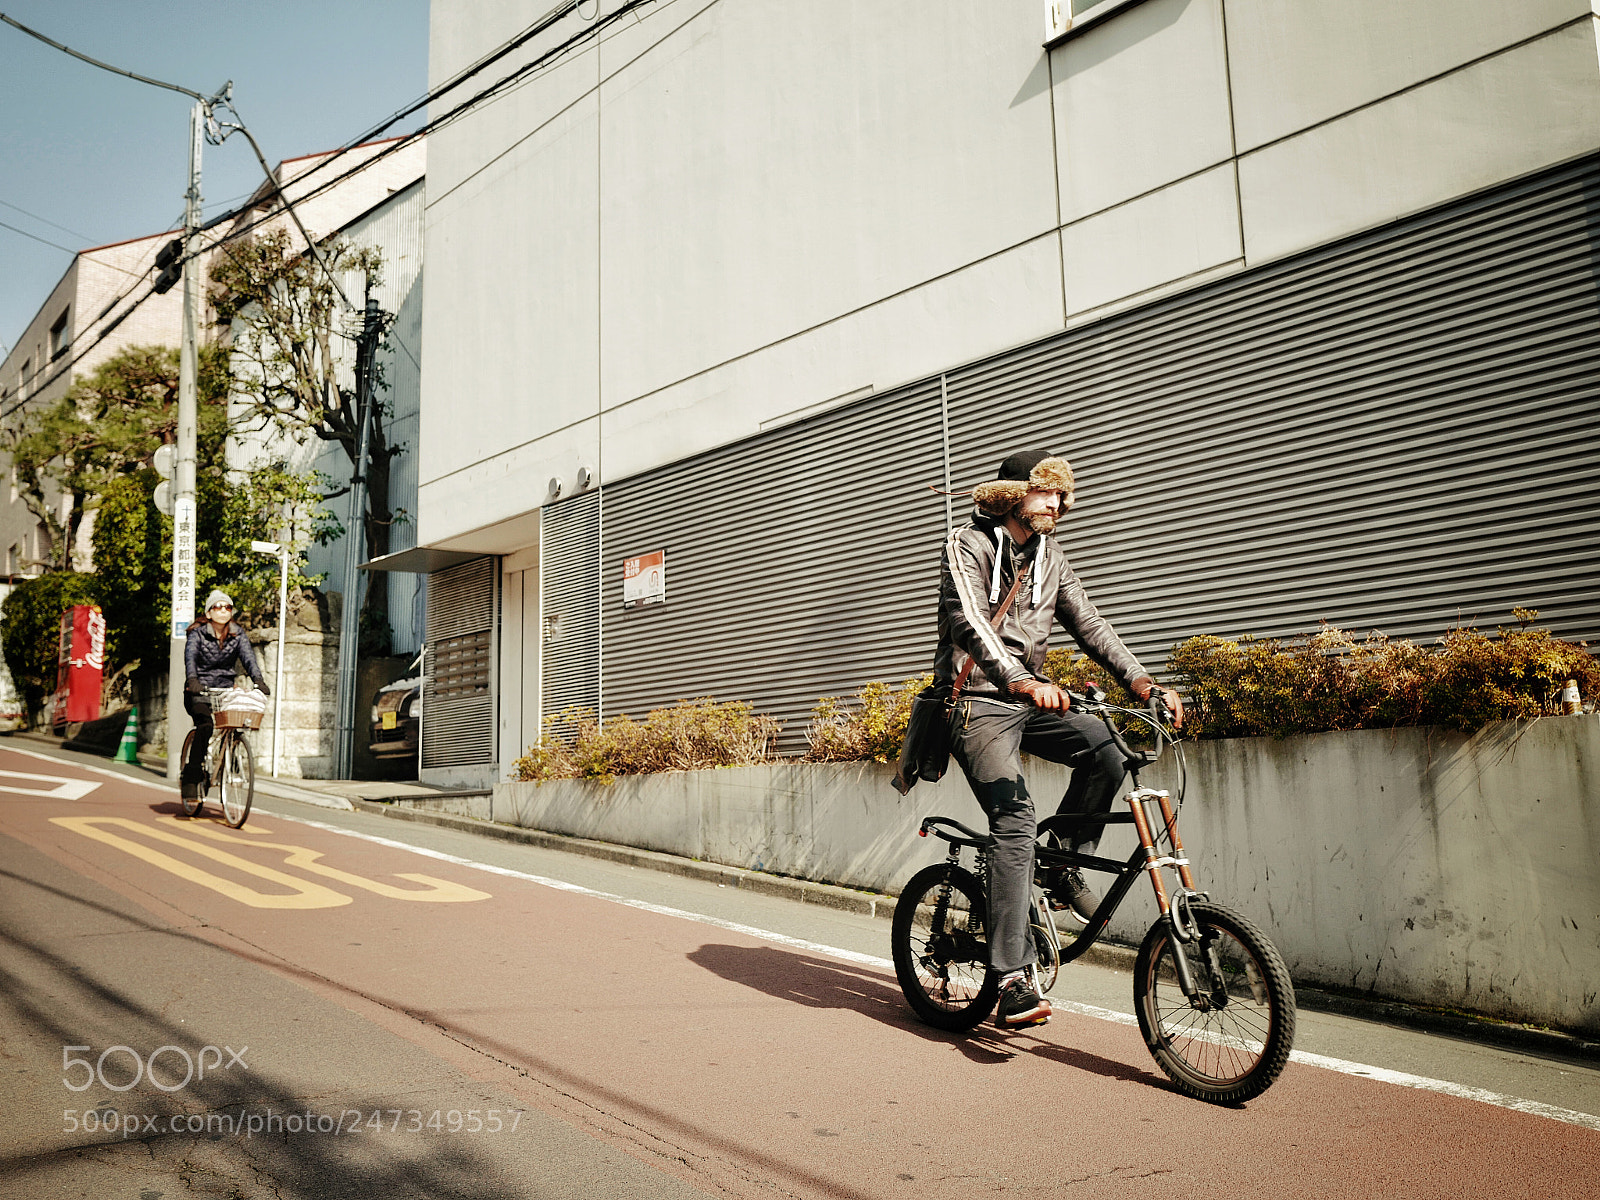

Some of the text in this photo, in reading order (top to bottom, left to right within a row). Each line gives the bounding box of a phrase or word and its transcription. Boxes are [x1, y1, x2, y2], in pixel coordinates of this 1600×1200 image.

[178, 522, 190, 601] 東京都民教会
